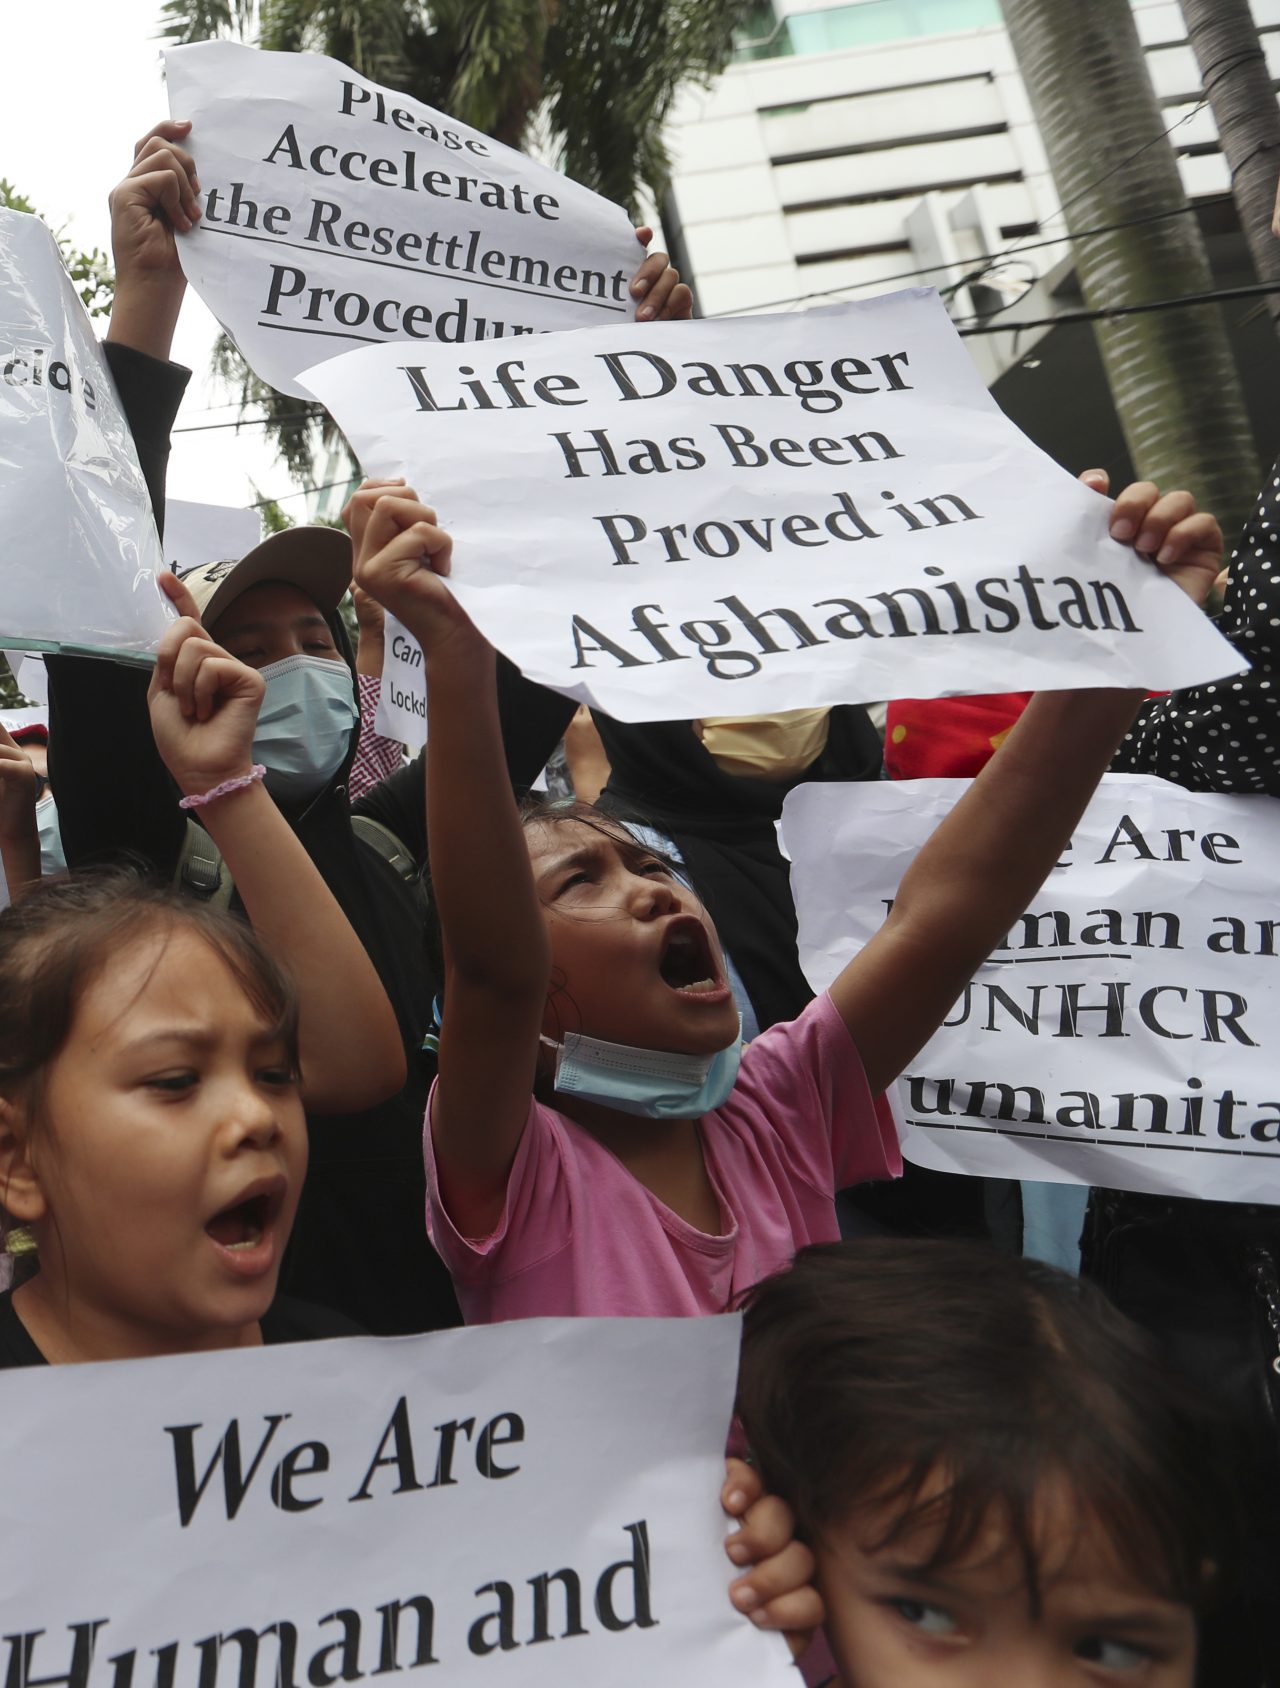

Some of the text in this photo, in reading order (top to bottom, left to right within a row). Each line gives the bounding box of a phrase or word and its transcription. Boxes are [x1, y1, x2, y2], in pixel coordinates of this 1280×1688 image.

[338, 79, 492, 158] Please
[263, 124, 561, 222] Accelerate
[205, 182, 628, 302] the Resettlement
[261, 264, 553, 343] Procedu
[397, 350, 915, 415] Life Danger
[548, 422, 906, 478] Has Been
[592, 489, 985, 566] Proved in
[569, 563, 1144, 681] Afghanistan
[1094, 815, 1243, 865] Are
[163, 1395, 526, 1529] We Are
[466, 1519, 660, 1657] and
